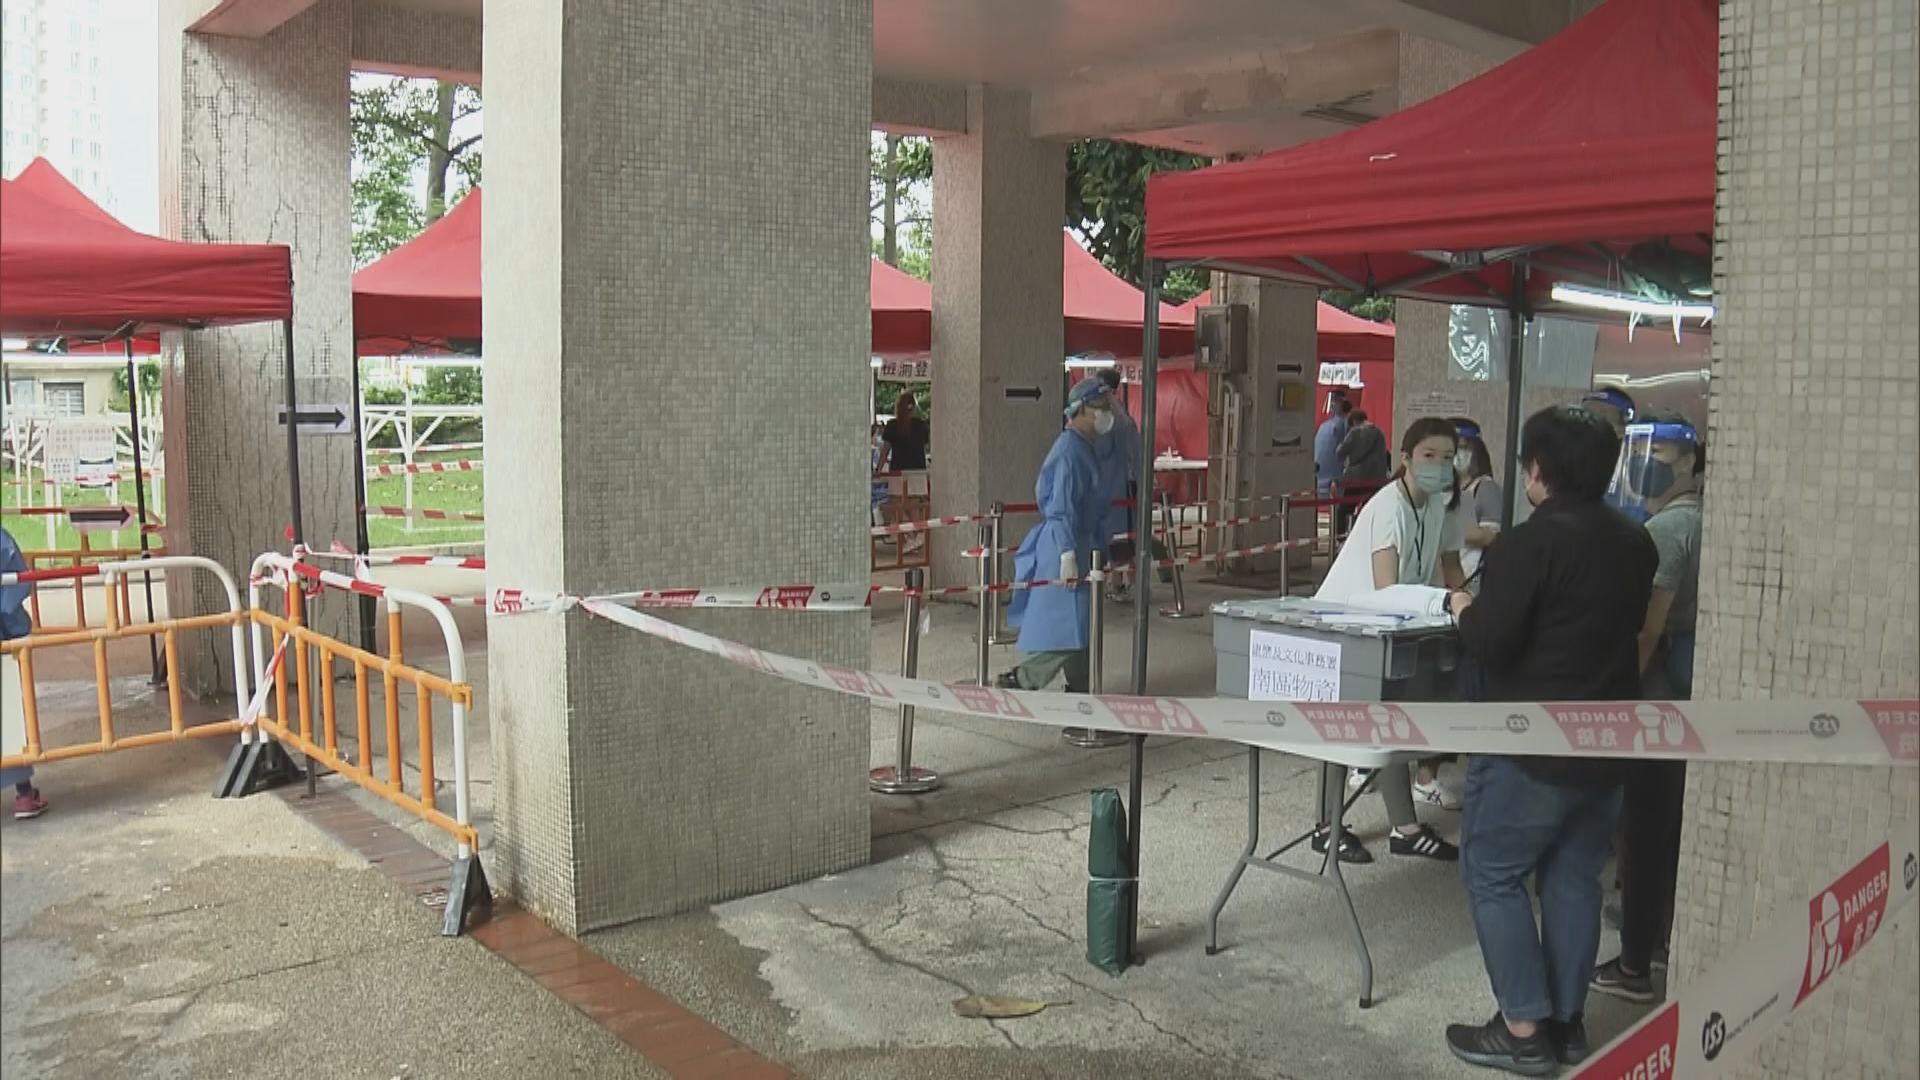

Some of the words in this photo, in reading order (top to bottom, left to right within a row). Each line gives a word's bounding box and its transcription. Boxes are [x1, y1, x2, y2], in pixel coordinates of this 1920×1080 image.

[1844, 870, 1888, 923] DANGER
[1702, 1016, 1725, 1057] ISS
[1617, 1043, 1672, 1080] GER
